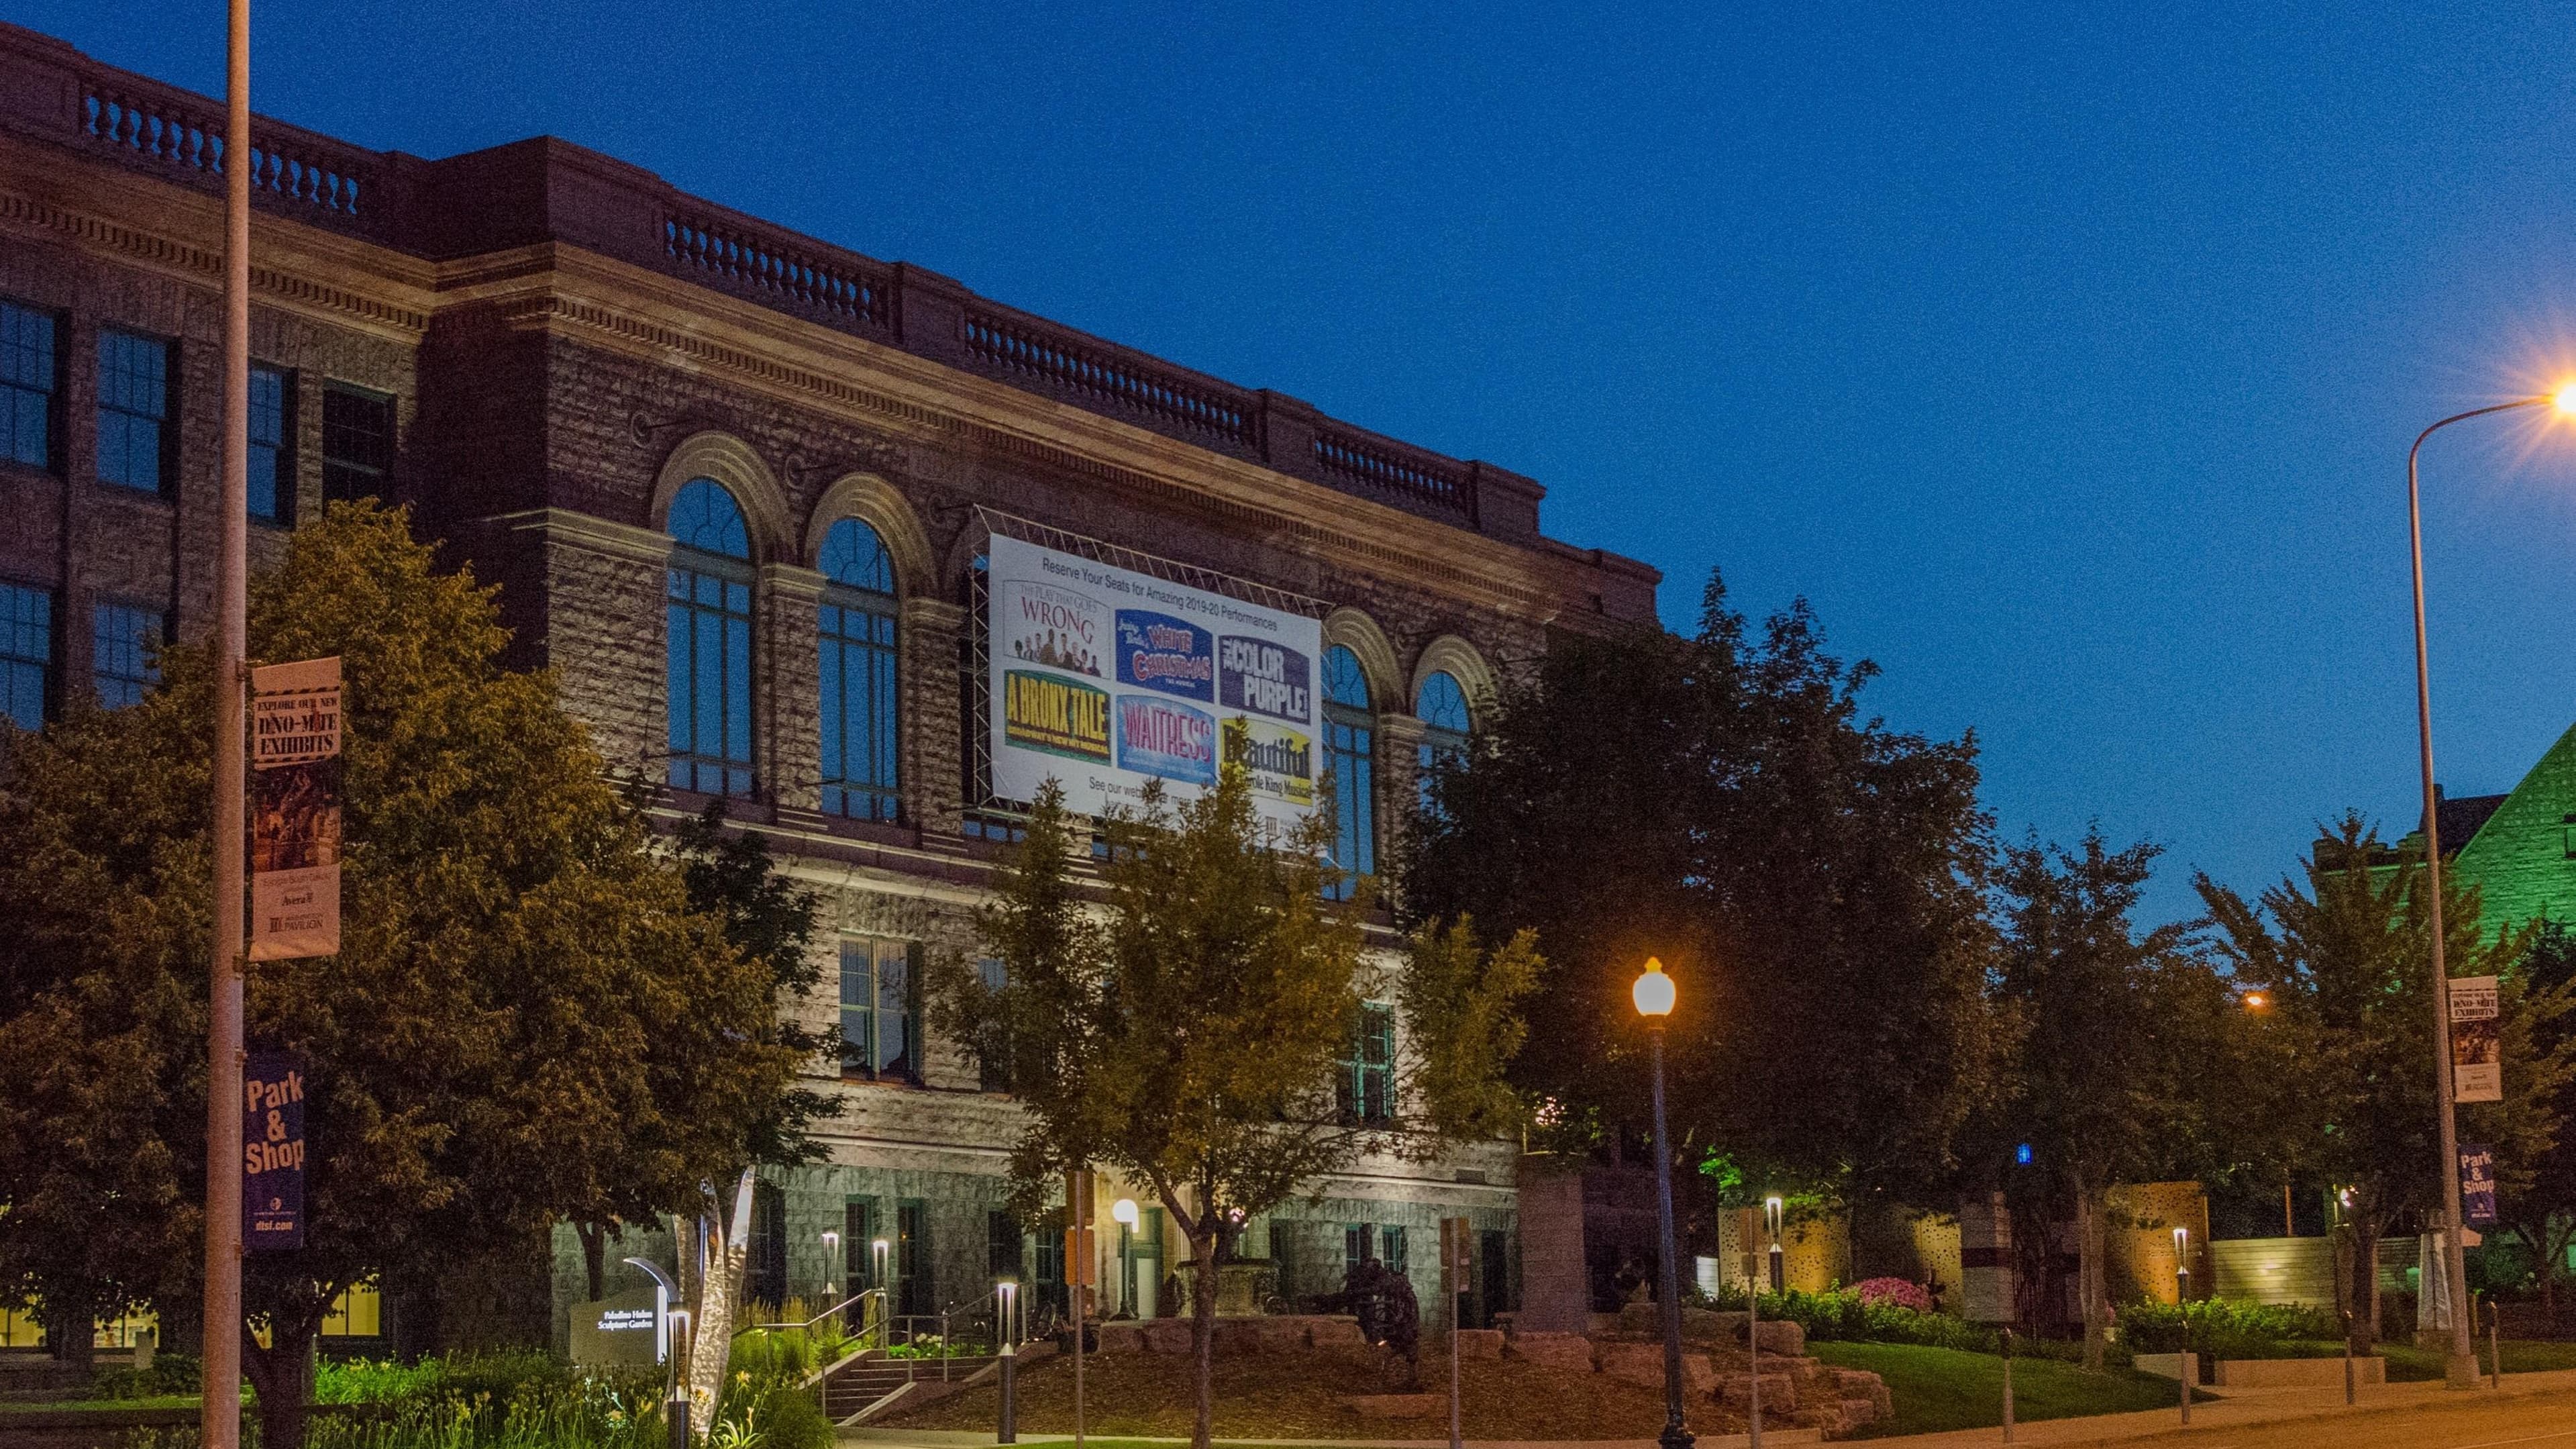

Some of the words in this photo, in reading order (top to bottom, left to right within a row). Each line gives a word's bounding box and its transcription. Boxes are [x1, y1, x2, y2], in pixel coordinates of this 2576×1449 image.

[1043, 558, 1080, 579] Reserve
[1082, 569, 1103, 585] Your
[1105, 574, 1130, 593] Seats
[1132, 581, 1144, 596] for
[1146, 587, 1184, 610] Amazing
[1186, 596, 1219, 616] 2019-20
[1221, 605, 1278, 632] Performances
[1074, 595, 1097, 613] GOES
[1021, 596, 1095, 644] WRONG
[1146, 624, 1194, 654] WHITE
[1133, 650, 1212, 681] CHRISTMAS
[1233, 639, 1284, 683] COLOR
[258, 700, 296, 711] EXPLORE
[299, 698, 317, 709] OUR
[321, 697, 337, 707] NEW
[1244, 674, 1308, 719] PURPLE
[1007, 673, 1018, 721] A
[1019, 676, 1070, 733] BRONX
[1070, 687, 1106, 741] TALE
[1123, 702, 1210, 763] WAITRESS
[260, 734, 333, 754] EXHIBITS
[1088, 776, 1106, 791] See
[1108, 783, 1121, 795] our
[1265, 776, 1283, 797] King
[1284, 779, 1312, 799] Musical
[282, 895, 306, 906] Avera
[285, 919, 323, 931] PAVILION
[2455, 1008, 2495, 1016] EXHIBITS
[247, 1070, 304, 1112] Park
[267, 1109, 287, 1142] &
[246, 1138, 304, 1175] Shop
[2461, 1151, 2491, 1168] Park
[2472, 1167, 2483, 1181] &
[2463, 1180, 2494, 1195] Shop
[256, 1220, 293, 1231] dtsf.com
[604, 1310, 631, 1319] Paladino
[598, 1321, 628, 1331] Sculpture
[629, 1319, 653, 1328] Garden
